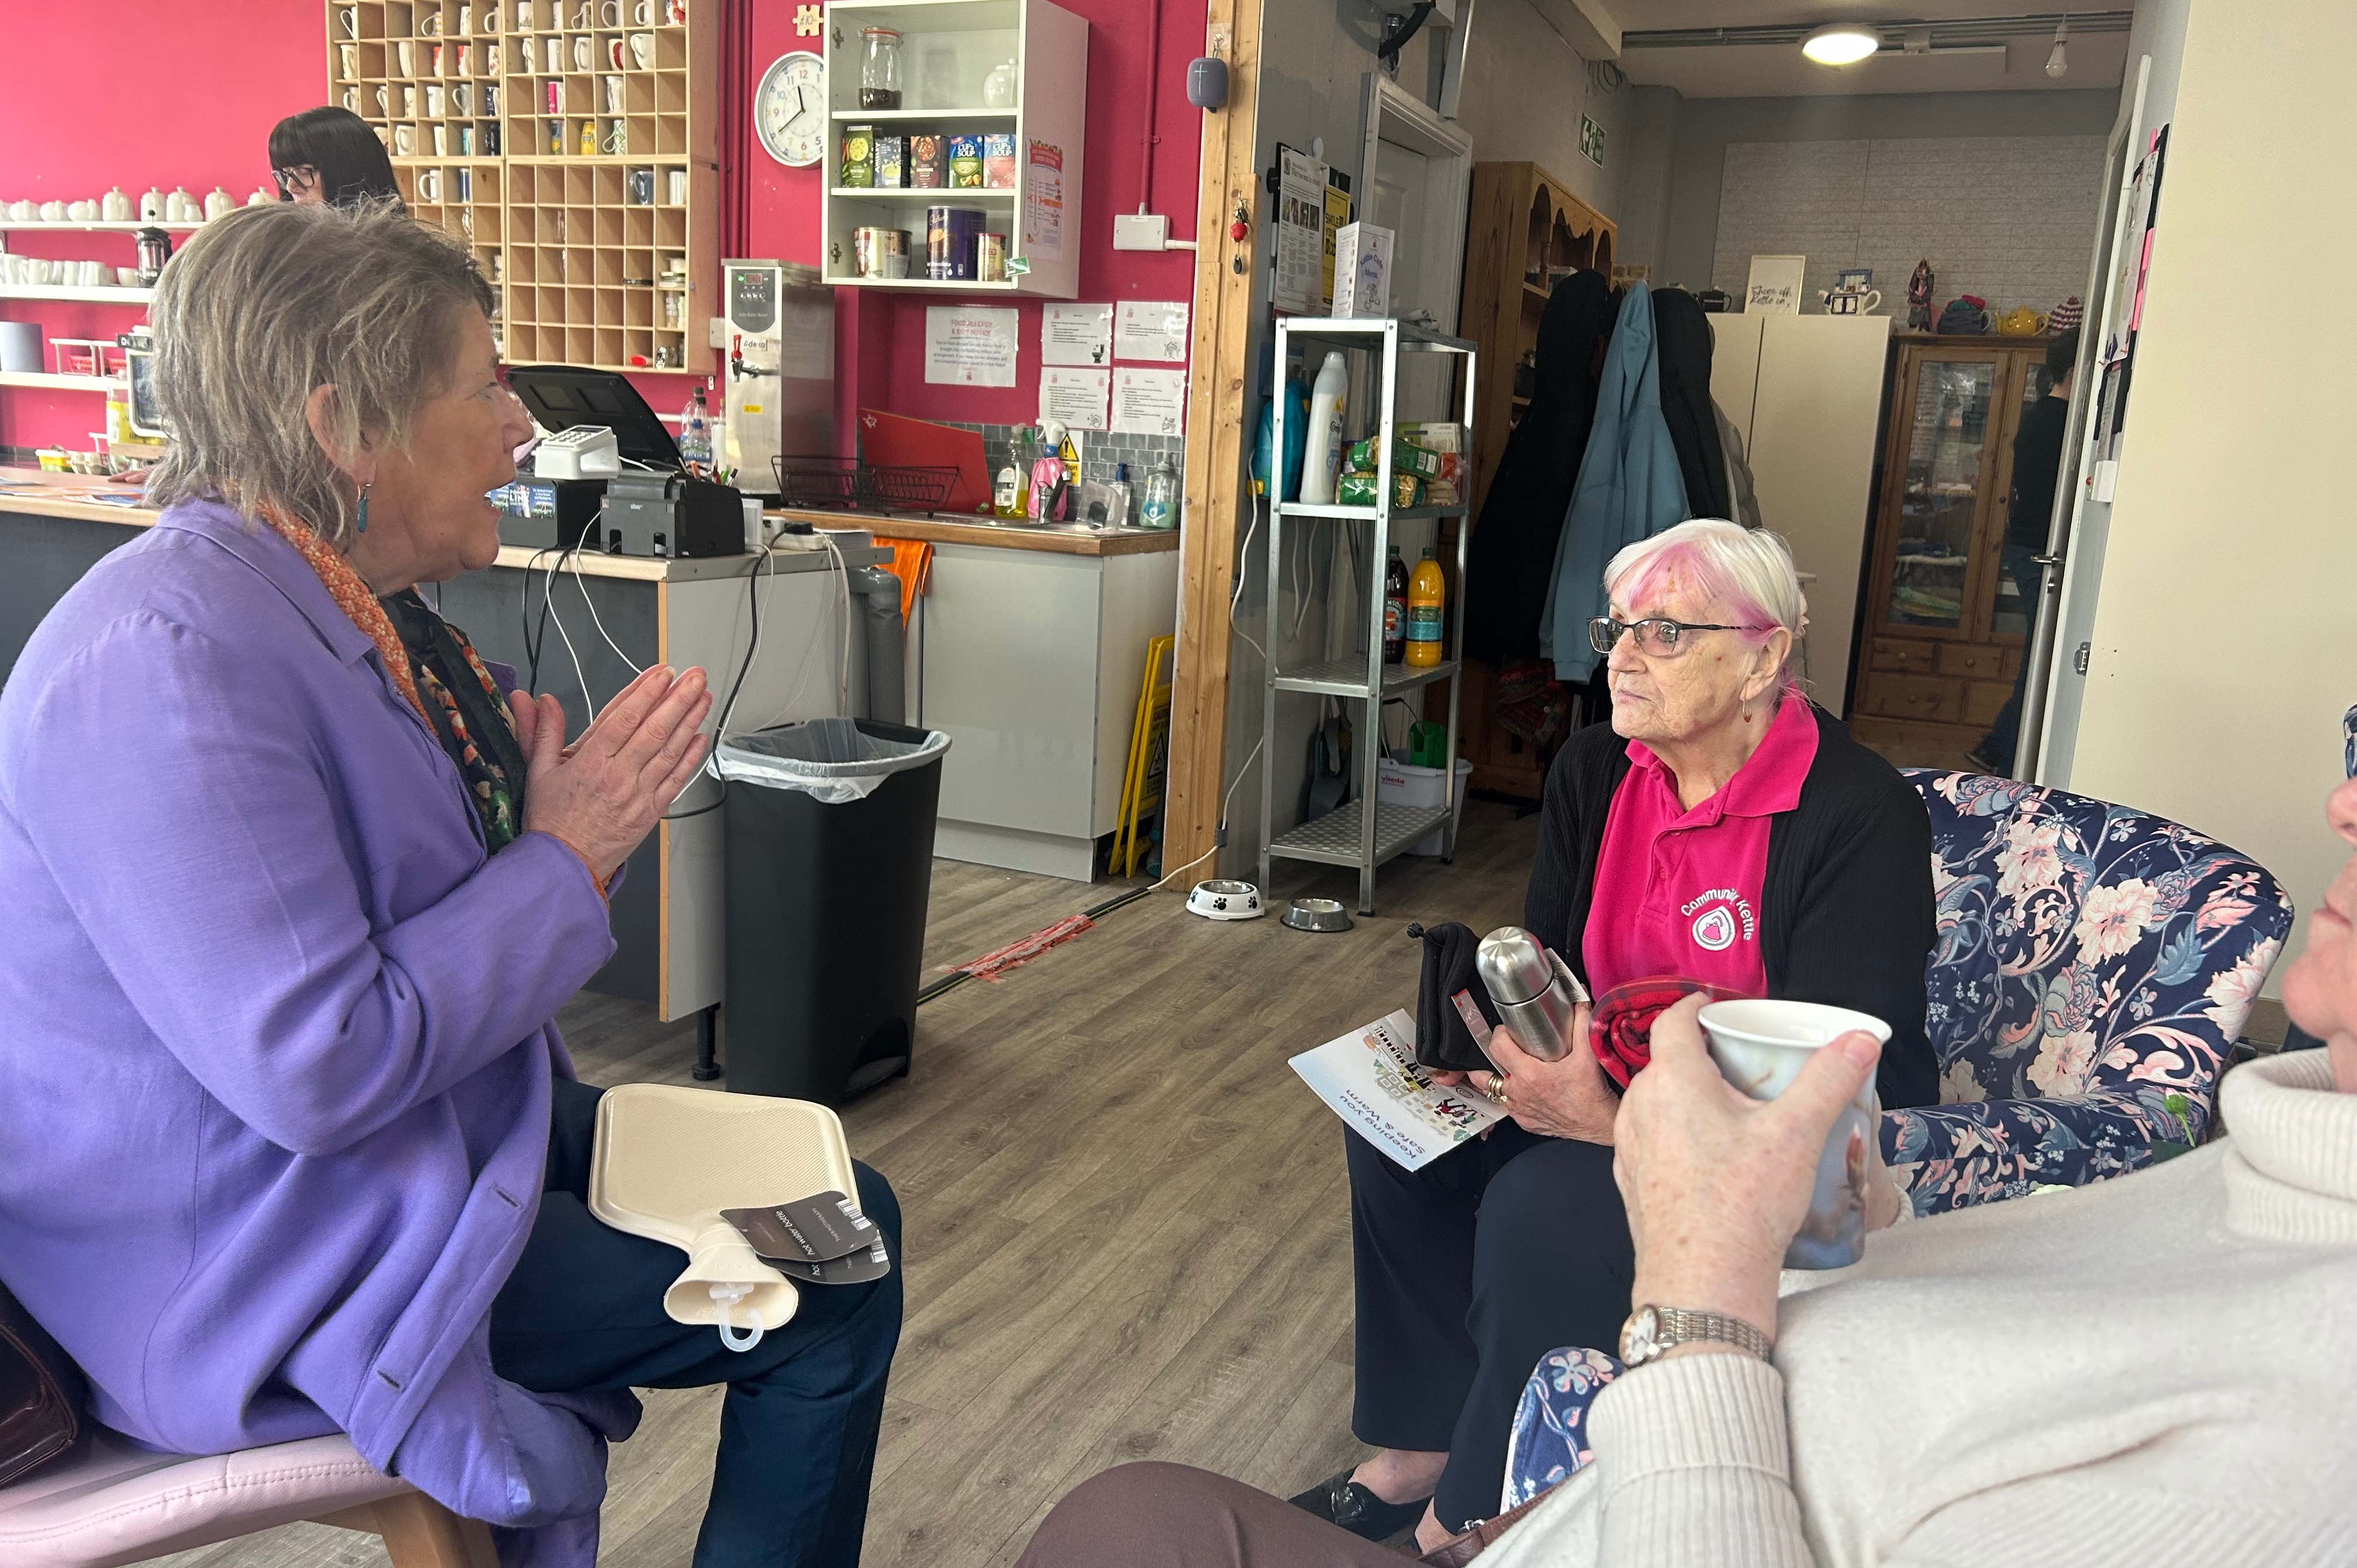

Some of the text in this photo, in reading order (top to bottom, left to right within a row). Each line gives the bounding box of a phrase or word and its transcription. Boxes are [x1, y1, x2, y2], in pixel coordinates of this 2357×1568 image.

[799, 70, 808, 79] 12
[787, 77, 794, 85] 11
[777, 91, 786, 100] 10
[773, 108, 779, 117] 9
[815, 136, 821, 146] 5
[801, 142, 807, 151] 6
[1681, 888, 1754, 940] Community Kettle
[1346, 1089, 1426, 1154] Safe & Warm
[1339, 1095, 1417, 1159] Keeping you
[775, 1210, 815, 1257] hot water bottle
